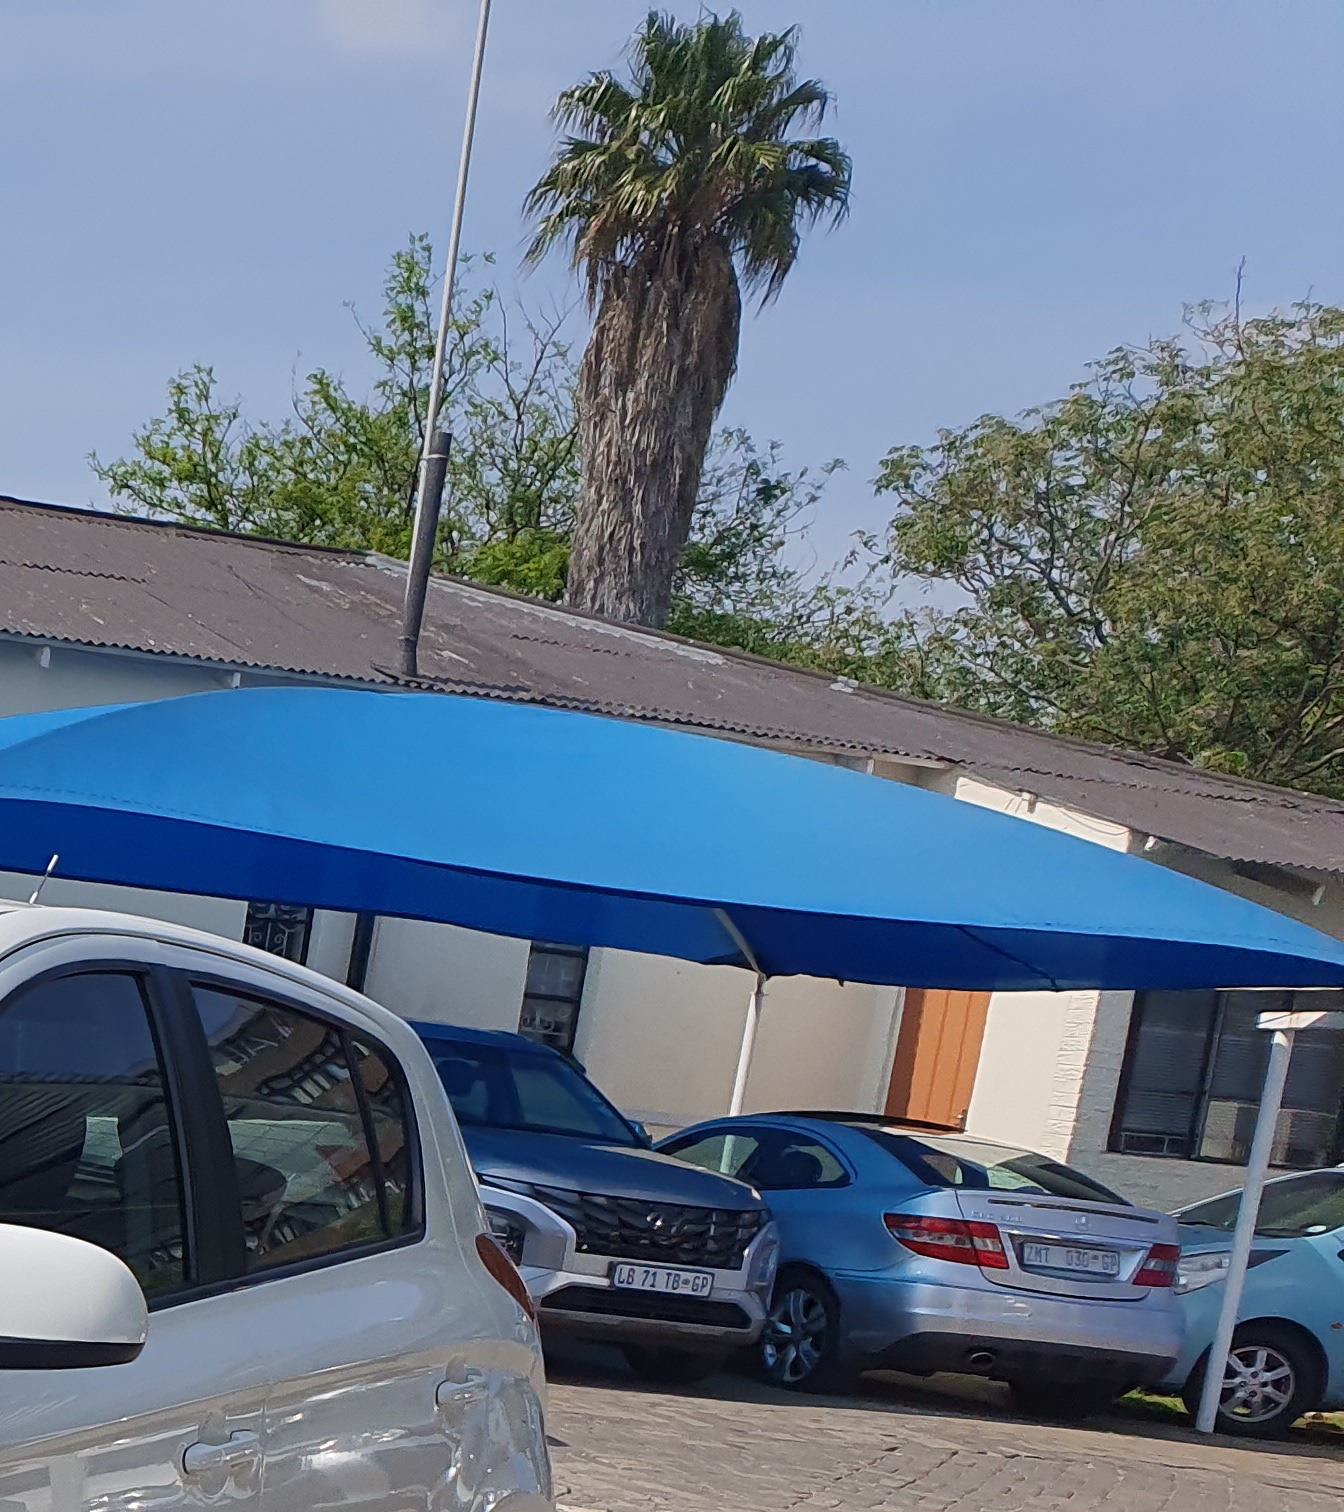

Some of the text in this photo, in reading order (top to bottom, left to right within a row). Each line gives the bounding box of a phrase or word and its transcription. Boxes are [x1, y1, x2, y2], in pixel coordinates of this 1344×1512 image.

[1101, 1253, 1117, 1271] GP
[640, 1269, 658, 1289] 71
[664, 1272, 681, 1291] TB
[691, 1275, 709, 1293] GP
